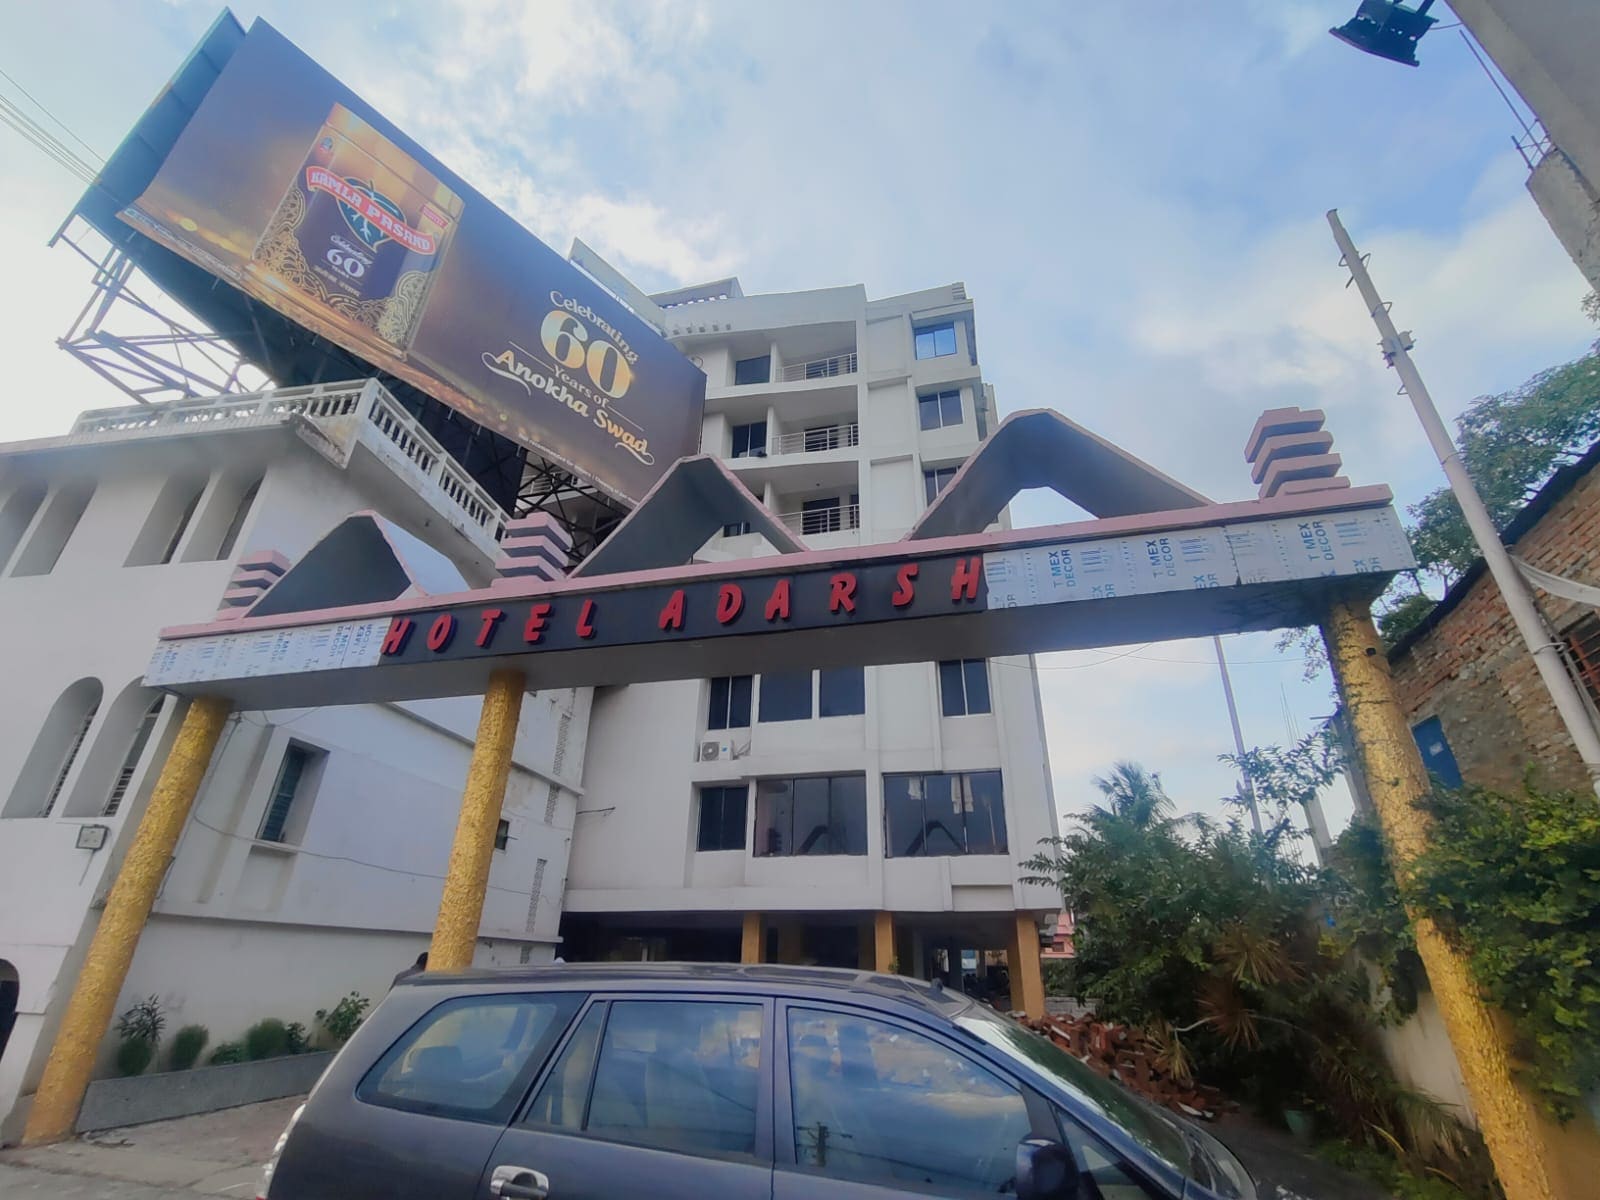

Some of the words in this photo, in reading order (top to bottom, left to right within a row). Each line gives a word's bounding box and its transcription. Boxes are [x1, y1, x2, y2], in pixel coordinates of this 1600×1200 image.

[311, 171, 363, 207] KAMLA
[366, 204, 431, 251] PASAND
[326, 248, 365, 278] 60
[540, 310, 633, 399] 60
[550, 290, 640, 366] Celebrating
[484, 350, 590, 418] Anokha
[593, 409, 651, 456] Swad
[553, 364, 592, 398] Years
[593, 394, 609, 408] of
[1060, 549, 1077, 588] DECOR
[1159, 537, 1177, 577] DECOR
[1312, 520, 1335, 561] DECOR
[379, 599, 596, 657] HOTEL
[657, 556, 981, 631] ADARSH
